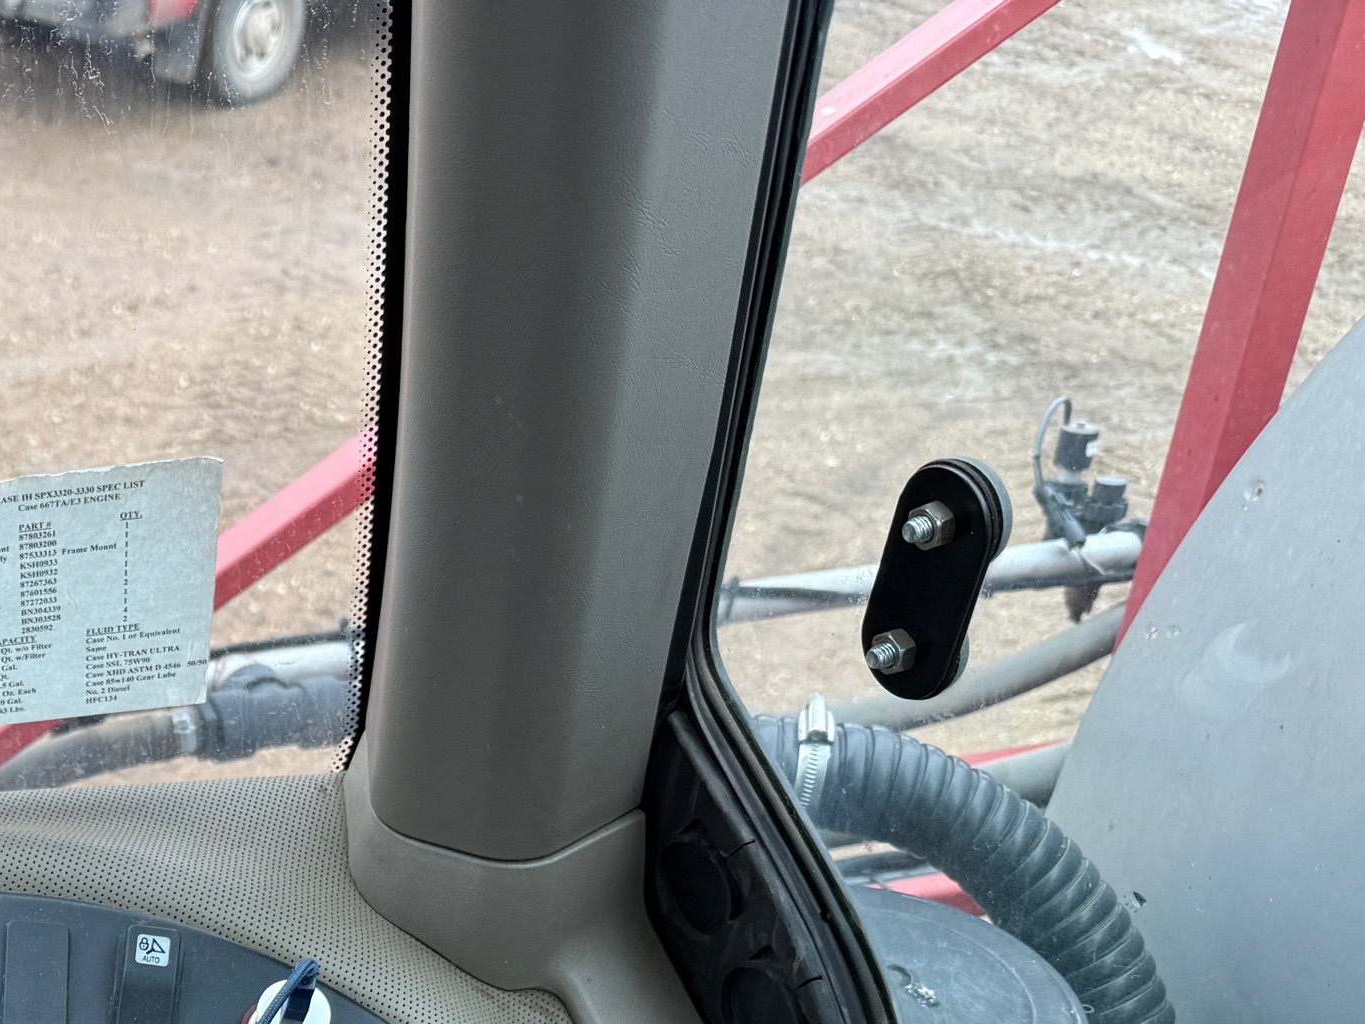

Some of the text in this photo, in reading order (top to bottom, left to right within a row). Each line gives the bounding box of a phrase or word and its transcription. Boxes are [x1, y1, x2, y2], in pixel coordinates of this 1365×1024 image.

[35, 487, 95, 500] SPX3320-3330
[97, 483, 121, 493] SPEC
[124, 480, 145, 489] LIST
[40, 498, 81, 509] 667TA/E3
[84, 493, 120, 503] ENGINE
[120, 511, 142, 520] QTY.
[19, 522, 43, 532] PART
[19, 530, 55, 541] 87803261
[19, 540, 56, 550] 87803200
[62, 547, 87, 555] Frame
[90, 543, 117, 551] Mount
[20, 559, 58, 569] KSH0933
[20, 568, 58, 579] KSH0932
[20, 578, 57, 588] 87267363
[20, 587, 57, 597] 87601556
[86, 627, 113, 636] FLUID
[140, 628, 180, 639] Equivalent
[107, 648, 147, 659] HY-TRAN
[150, 645, 180, 654] ULTRA
[106, 669, 125, 677] XHD
[128, 665, 153, 674] ASTM
